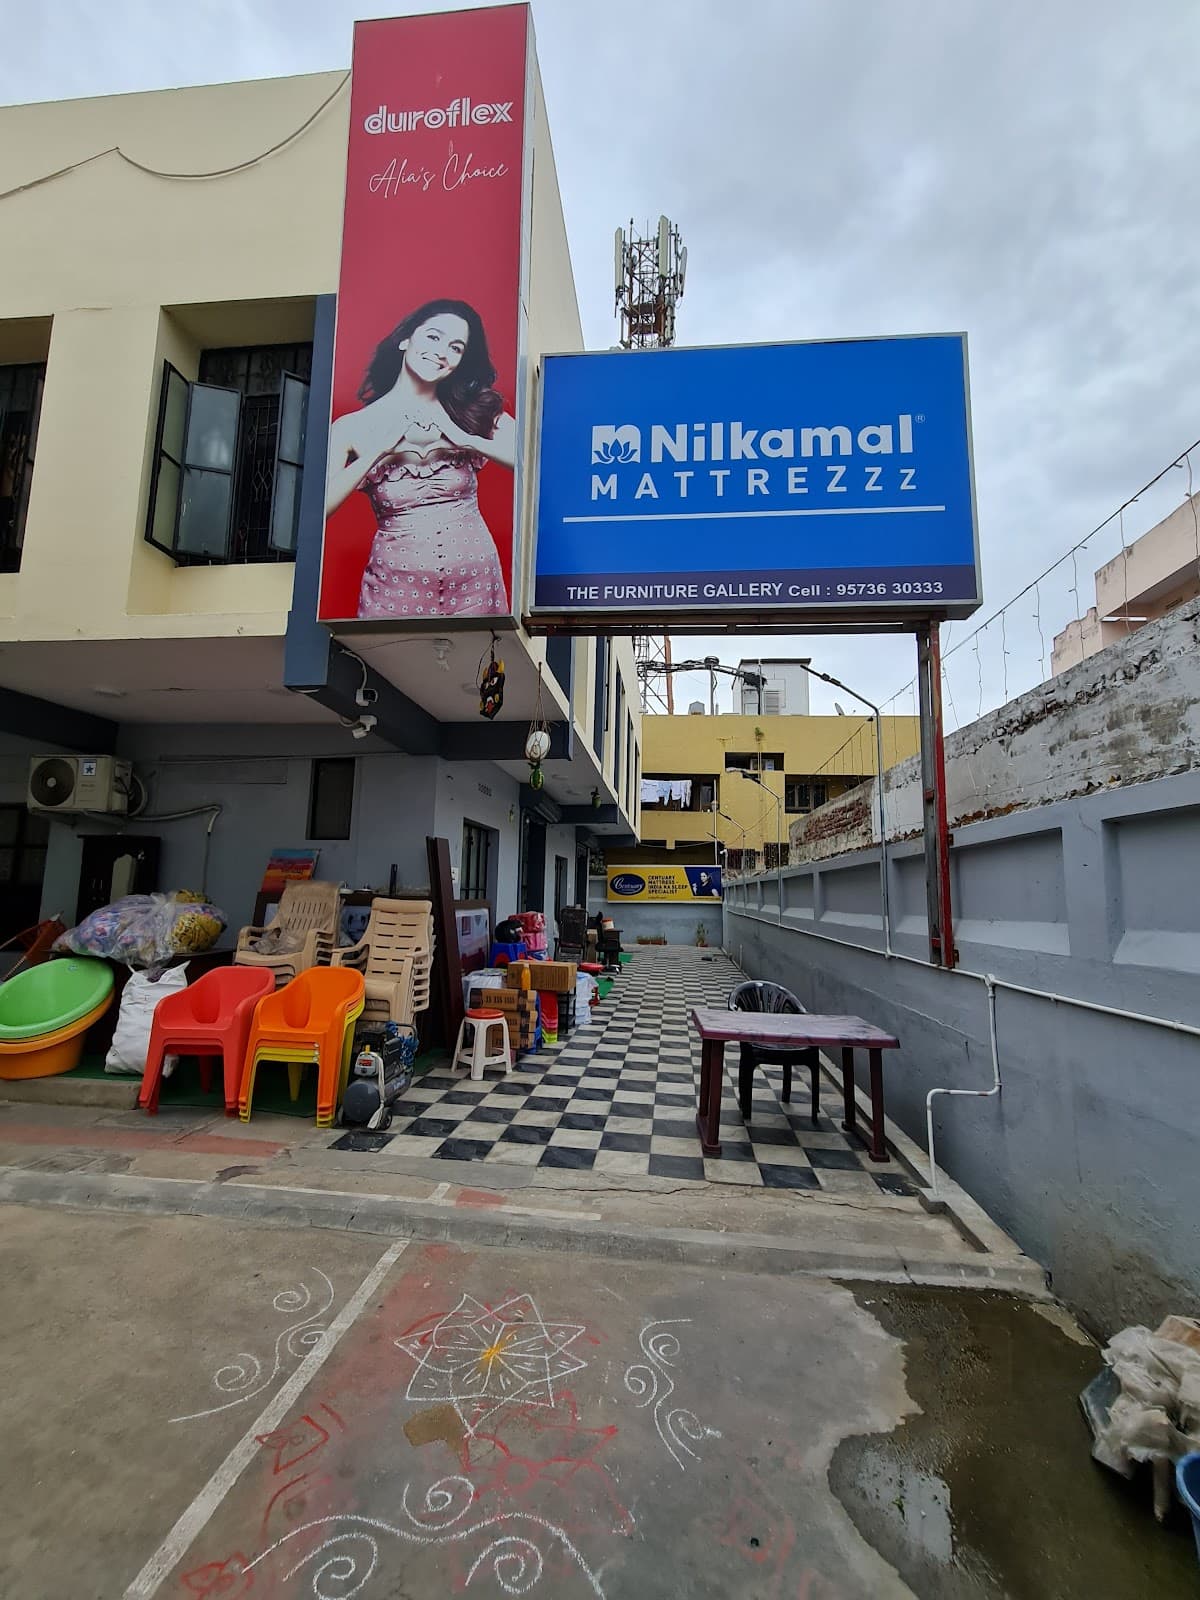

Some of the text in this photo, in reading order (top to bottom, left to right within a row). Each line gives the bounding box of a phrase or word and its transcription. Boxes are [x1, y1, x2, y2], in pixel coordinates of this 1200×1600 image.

[364, 97, 514, 135] duroflex
[369, 153, 509, 199] Alia's Choice
[650, 415, 913, 463] Nilkamal
[591, 466, 918, 501] MATTREZZZ
[566, 586, 599, 600] THE
[603, 584, 699, 600] FURNITURE
[703, 583, 783, 598] GALLERY
[788, 584, 822, 597] Cell
[836, 583, 887, 596] 95736
[892, 582, 943, 595] 30333
